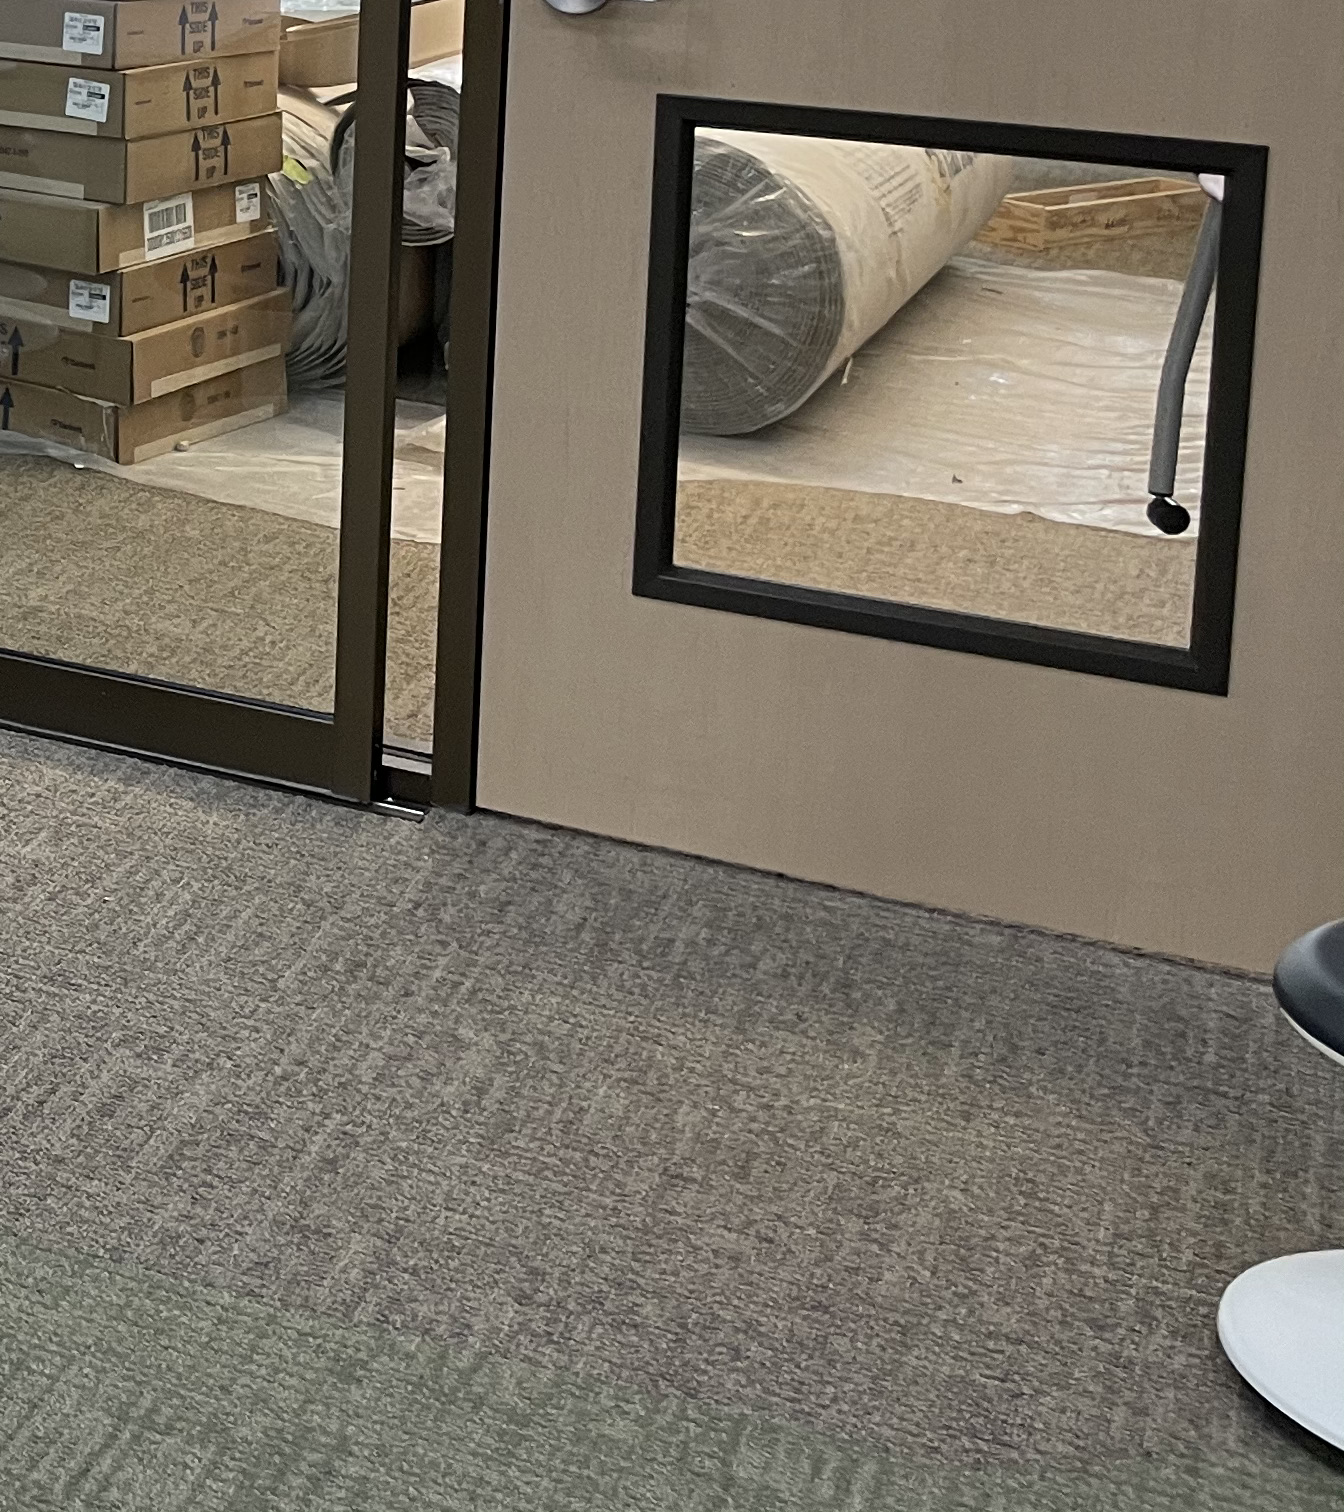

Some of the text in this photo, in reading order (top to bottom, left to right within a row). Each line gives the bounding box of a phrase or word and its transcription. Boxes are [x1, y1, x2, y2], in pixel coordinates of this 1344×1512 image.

[190, 1, 208, 14] THIS
[188, 20, 208, 34] SIDE
[192, 40, 204, 54] UP
[192, 66, 211, 82] THIS
[192, 86, 211, 99] SIDE
[196, 105, 208, 120] UP
[201, 125, 220, 141] THIS
[201, 146, 221, 160] SIDE
[190, 255, 209, 271] THIS
